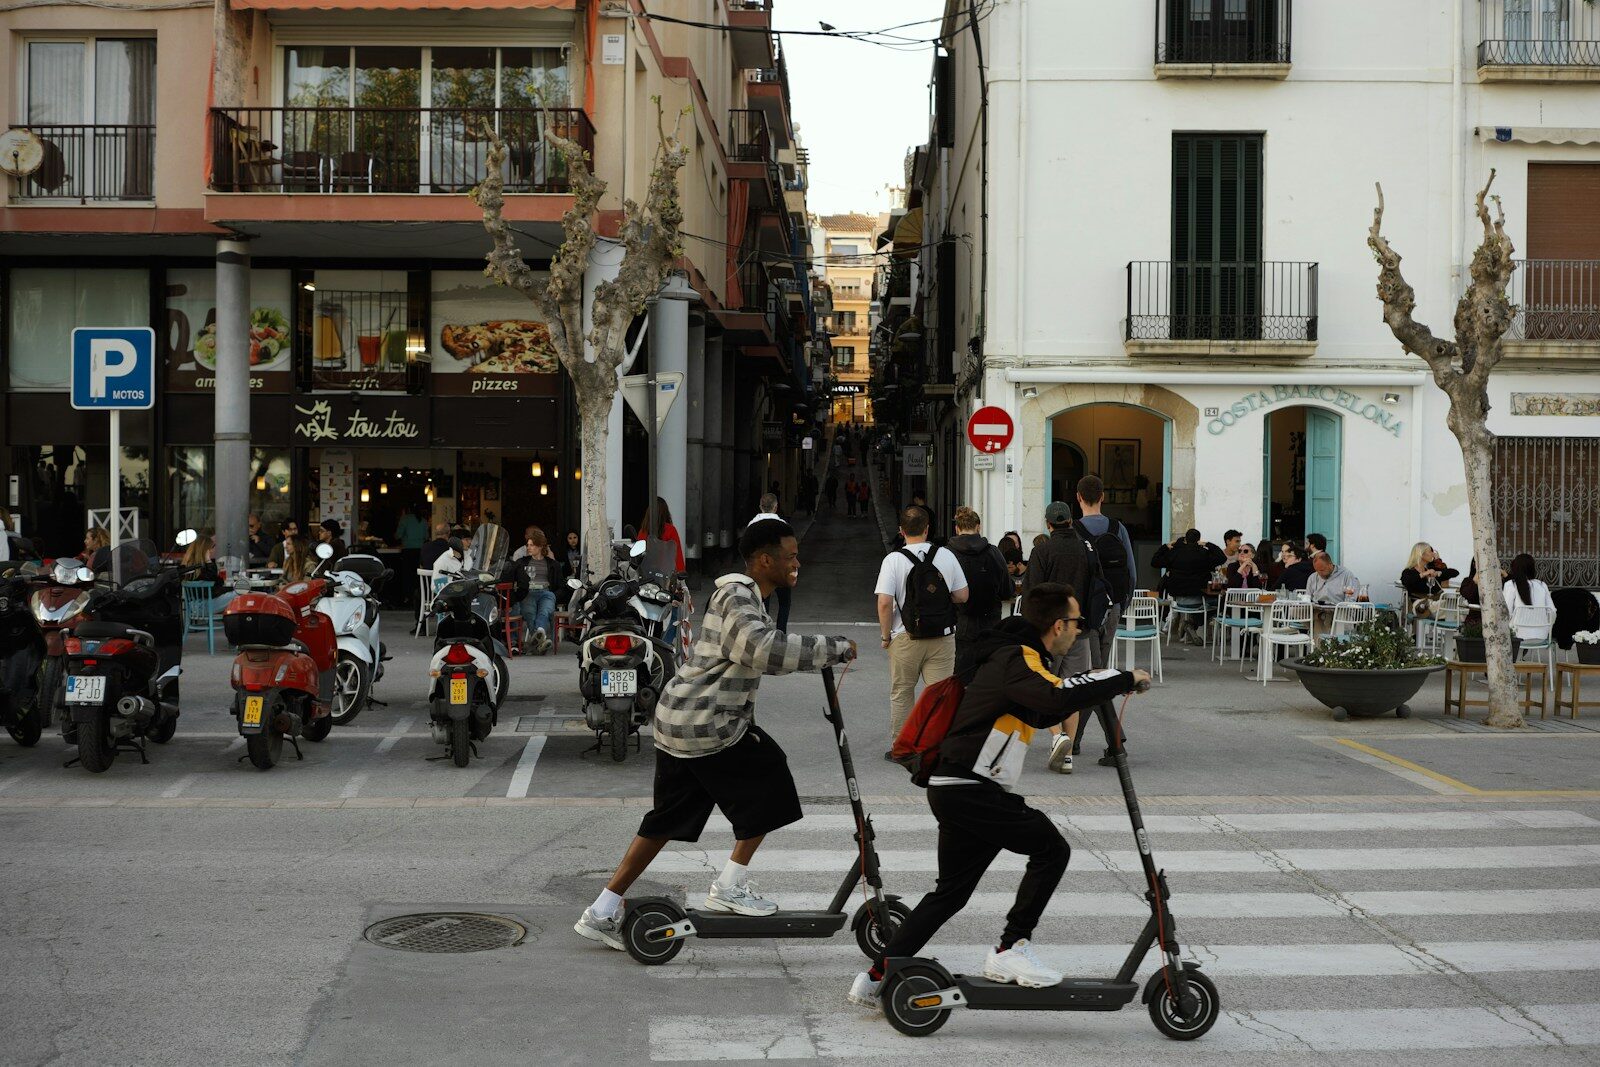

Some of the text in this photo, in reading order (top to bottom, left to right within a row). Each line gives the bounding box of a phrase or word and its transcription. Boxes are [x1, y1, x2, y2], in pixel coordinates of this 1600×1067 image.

[90, 338, 137, 398] P
[471, 377, 519, 393] pizzes
[112, 390, 145, 400] MOTOS
[1207, 384, 1404, 437] COSTA BARCELONA
[343, 408, 419, 438] tou tou
[609, 671, 635, 681] 3829
[77, 688, 101, 699] FJD
[609, 682, 629, 692] HTB
